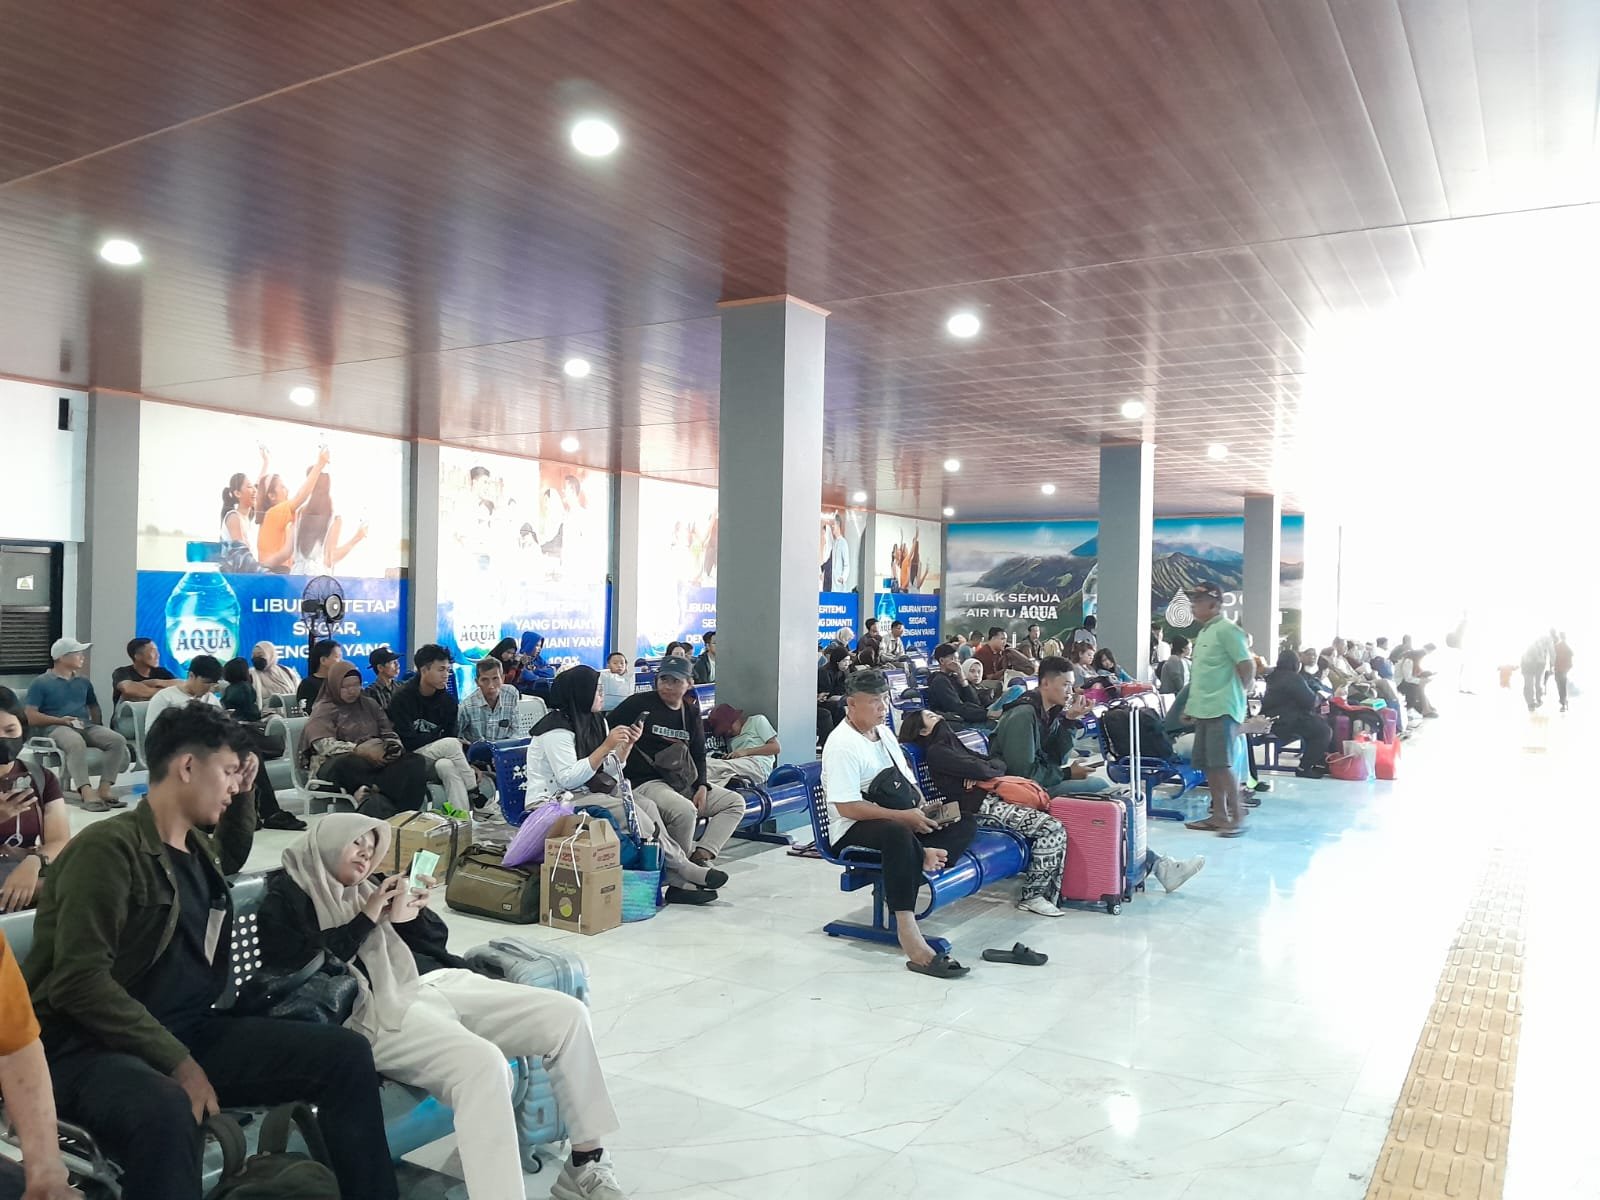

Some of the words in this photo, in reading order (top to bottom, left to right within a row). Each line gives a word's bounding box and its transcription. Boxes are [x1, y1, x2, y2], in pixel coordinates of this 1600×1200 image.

[963, 593, 1004, 602] TIDAK
[1008, 594, 1060, 602] SEMUA
[966, 608, 989, 617] AIR
[993, 609, 1016, 617] ITU
[1019, 605, 1058, 621] AQUA
[515, 619, 549, 630] YANG
[176, 629, 231, 653] AQUA
[459, 624, 496, 645] AQUA
[572, 637, 602, 648] YANG
